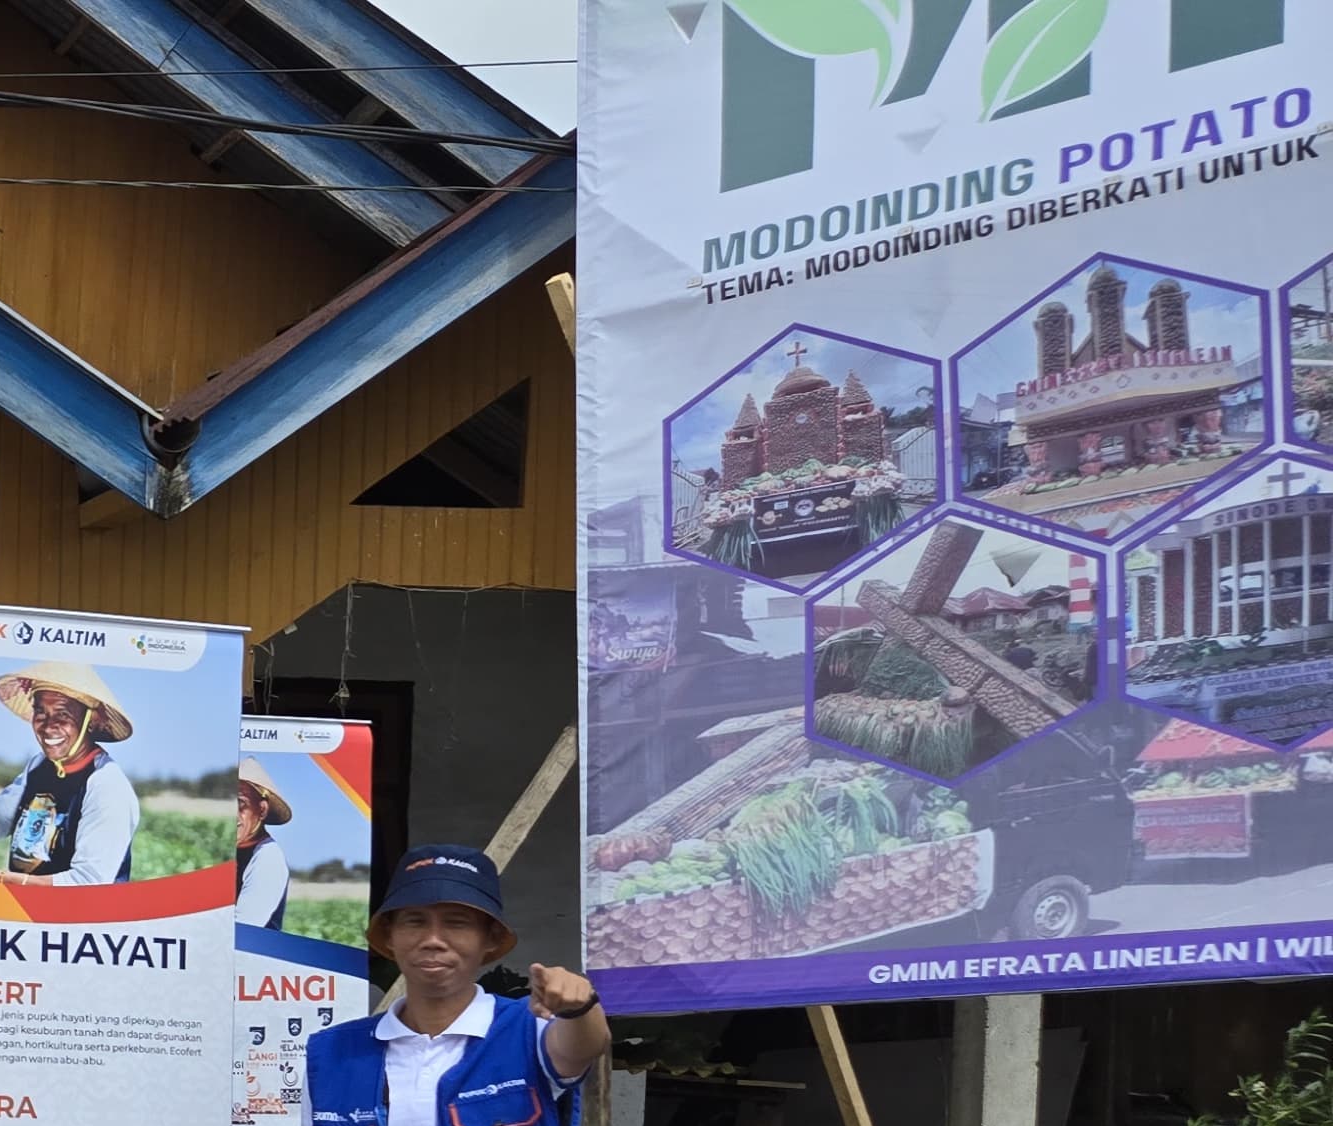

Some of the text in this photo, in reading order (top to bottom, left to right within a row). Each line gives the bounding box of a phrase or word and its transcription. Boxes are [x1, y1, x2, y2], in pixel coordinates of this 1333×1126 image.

[702, 156, 1035, 274] MODOINDING
[1058, 86, 1312, 185] POTATO
[703, 134, 1319, 305] TEMA: MODOINDING DIBERKATI UNTUK
[39, 628, 105, 647] KALTIM
[41, 932, 186, 970] HAYATI
[868, 959, 958, 985] GMIM
[963, 951, 1084, 980] EFRATA
[1093, 941, 1249, 972] LINELEAN
